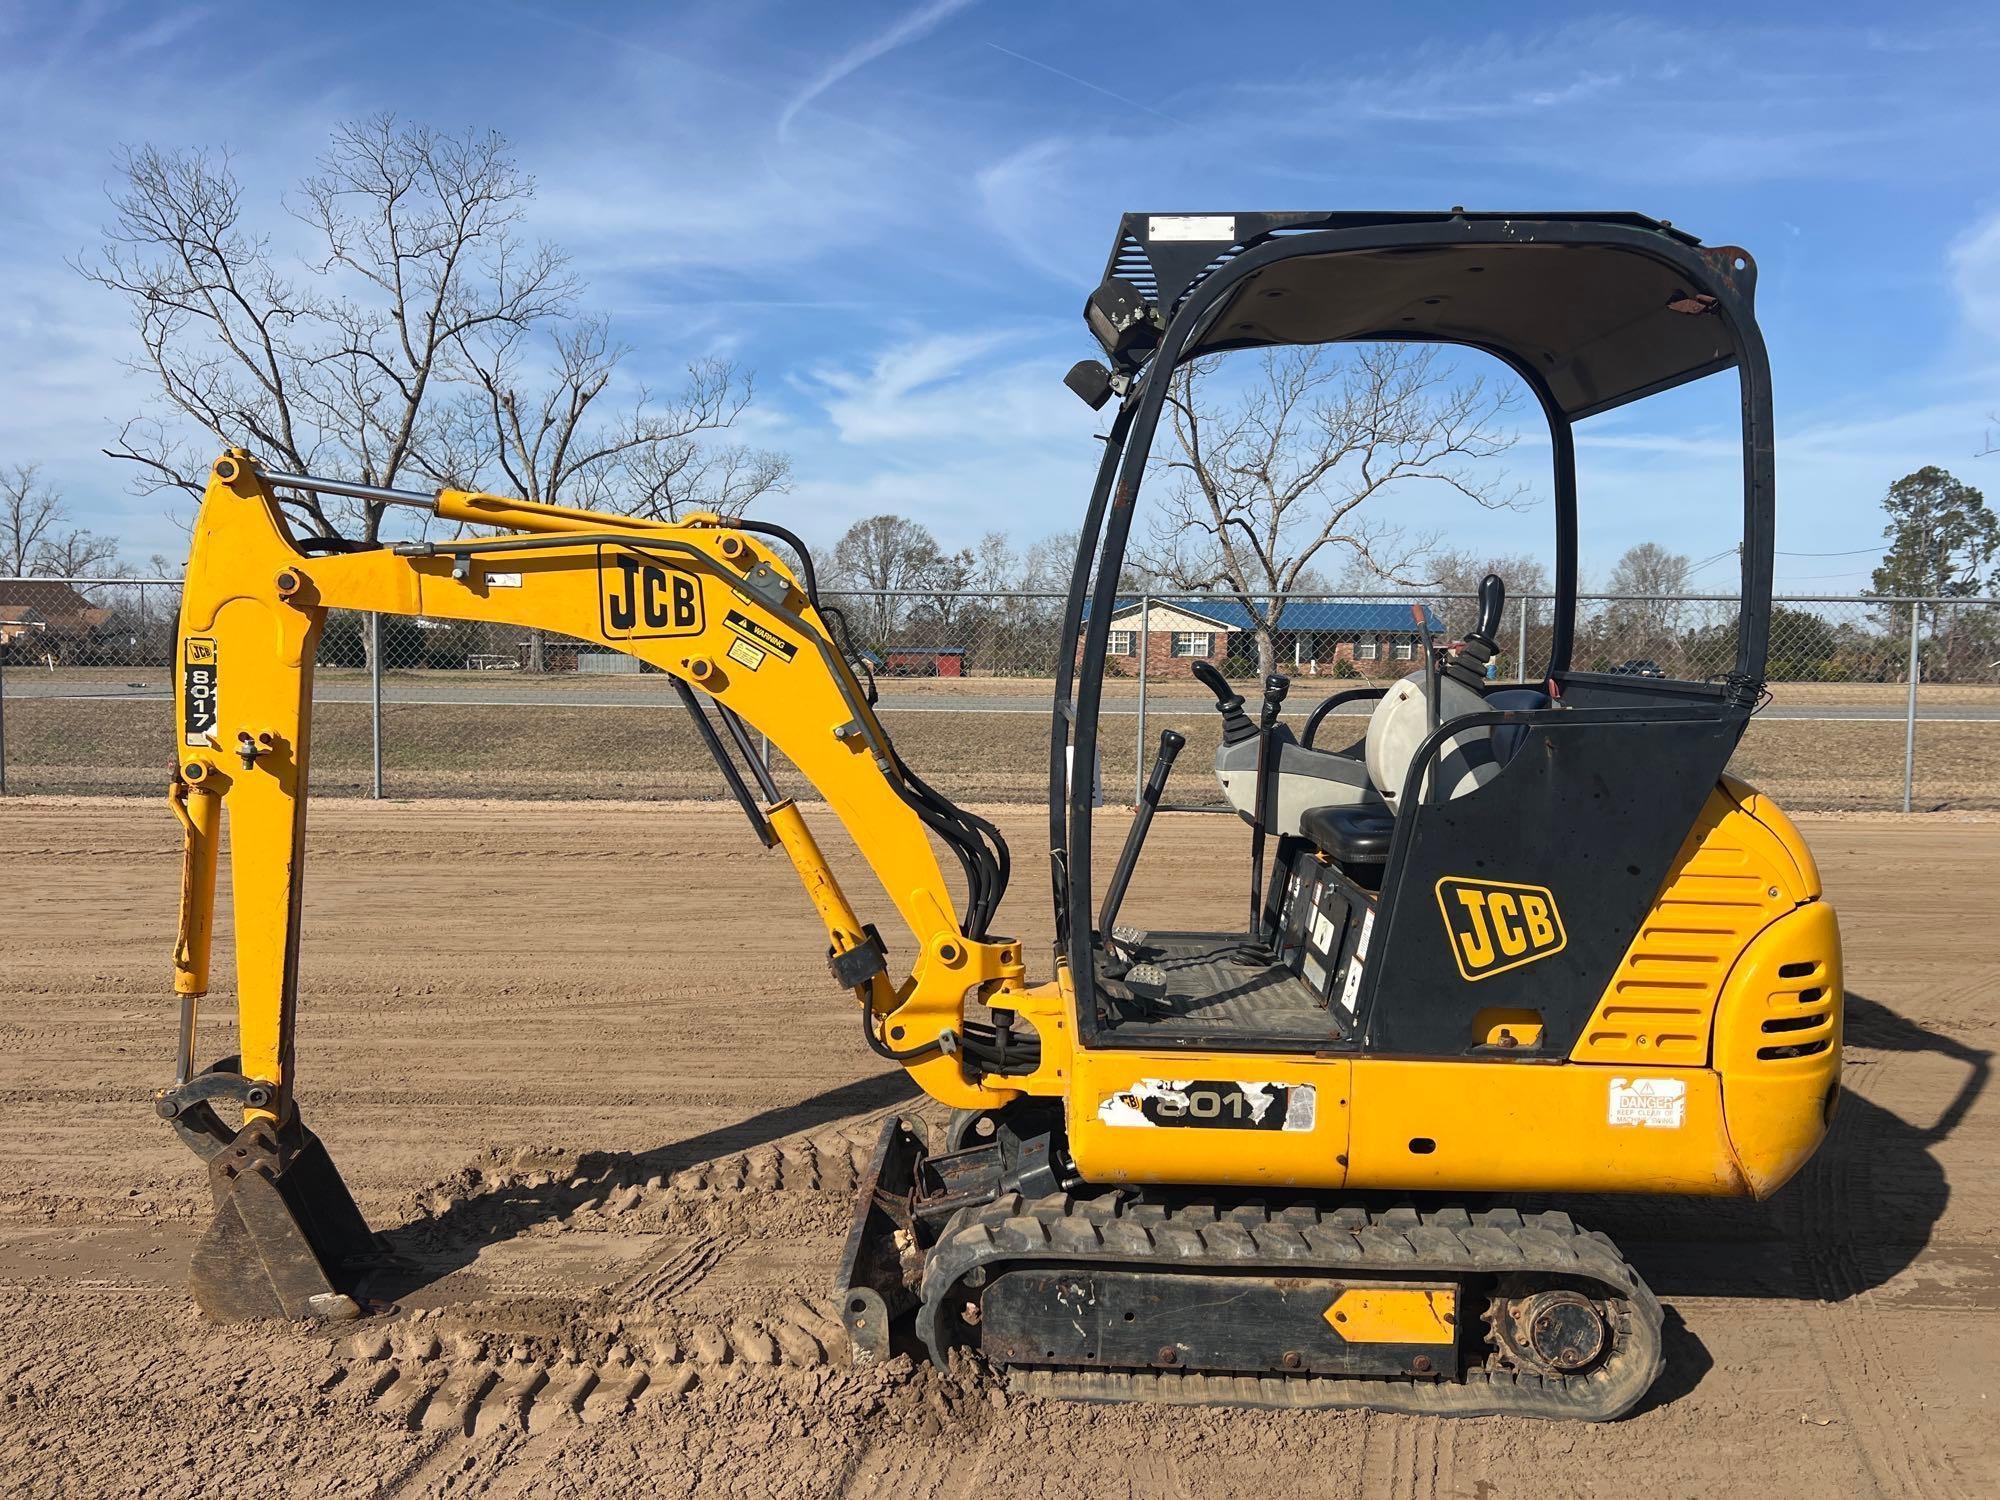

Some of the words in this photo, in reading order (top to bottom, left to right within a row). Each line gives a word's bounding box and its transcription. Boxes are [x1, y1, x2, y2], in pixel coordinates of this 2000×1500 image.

[609, 553, 695, 630] JCB
[193, 645, 212, 659] JCB
[753, 625, 786, 649] WARNING
[191, 670, 210, 727] 8017
[1456, 888, 1555, 968] JCB
[1621, 1096, 1673, 1109] DANGER
